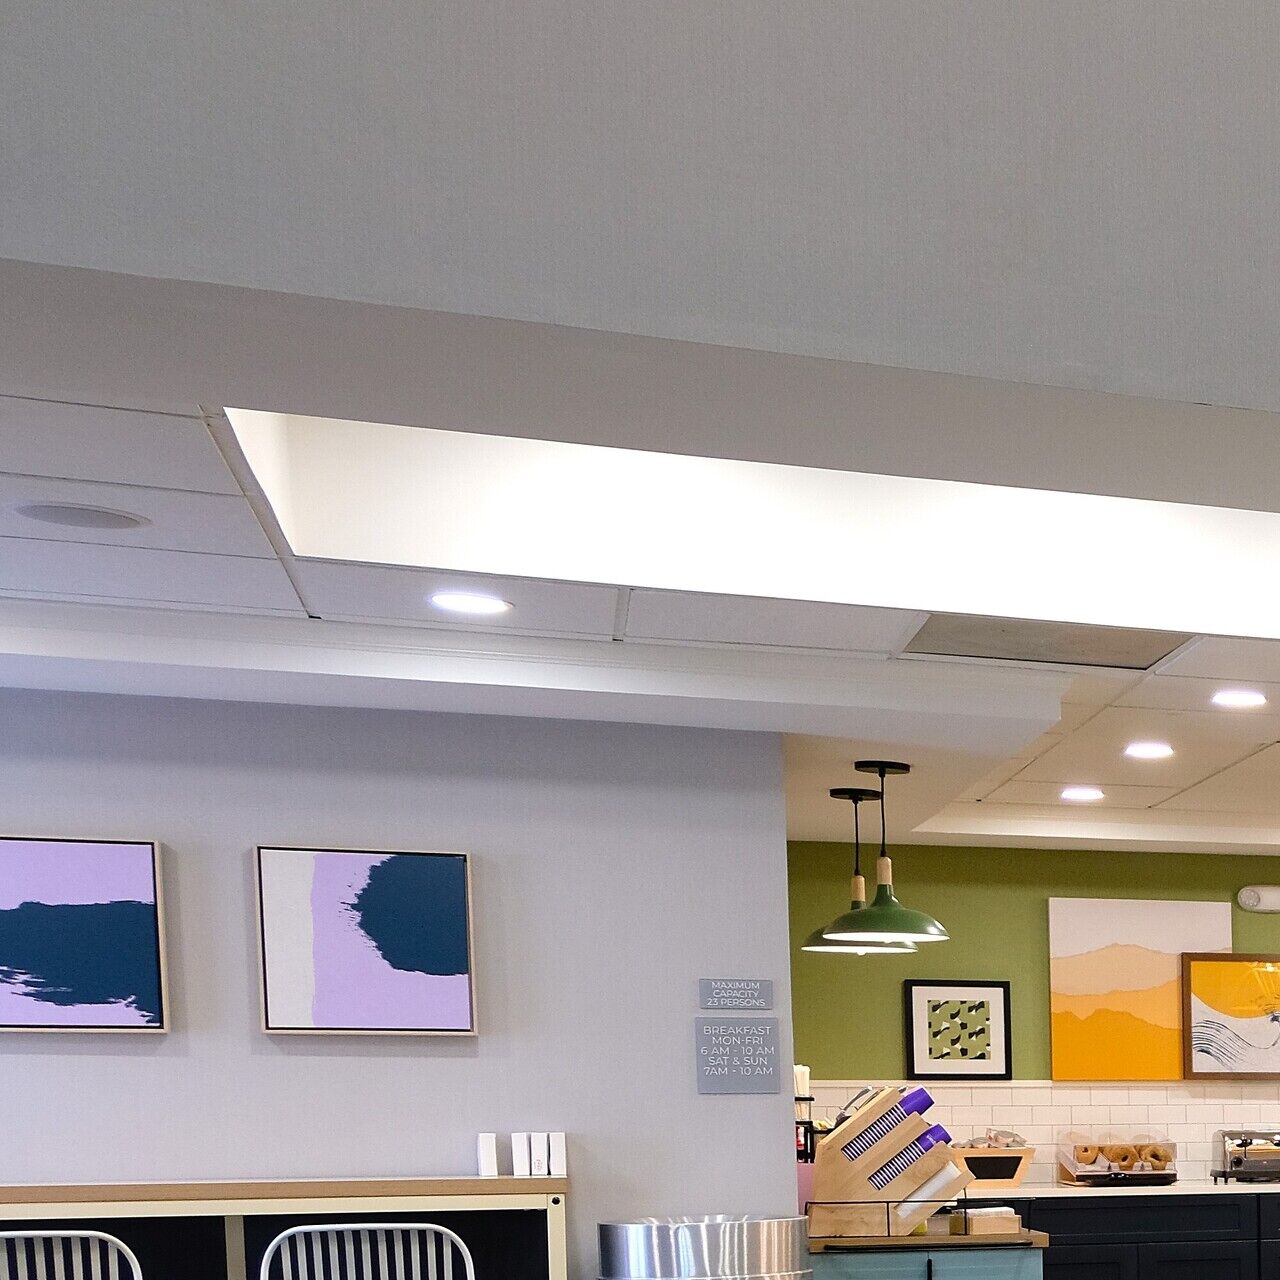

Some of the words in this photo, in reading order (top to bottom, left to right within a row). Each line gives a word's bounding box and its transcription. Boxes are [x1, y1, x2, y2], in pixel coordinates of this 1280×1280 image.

[711, 981, 760, 989] MAXIMUM
[712, 989, 759, 998] CAPACITY
[721, 998, 765, 1006] PERSONS
[703, 1026, 772, 1035] BREAKFAST
[711, 1036, 764, 1045] MON-FRI
[700, 1047, 708, 1055] 6
[711, 1047, 730, 1055] AM
[741, 1047, 753, 1055] 10
[756, 1047, 775, 1055] AM
[708, 1057, 729, 1066] SAT
[732, 1057, 740, 1065] &
[744, 1057, 768, 1066] SUN
[703, 1067, 728, 1075] 7AM
[740, 1067, 752, 1076] 10
[754, 1067, 773, 1075] AM
